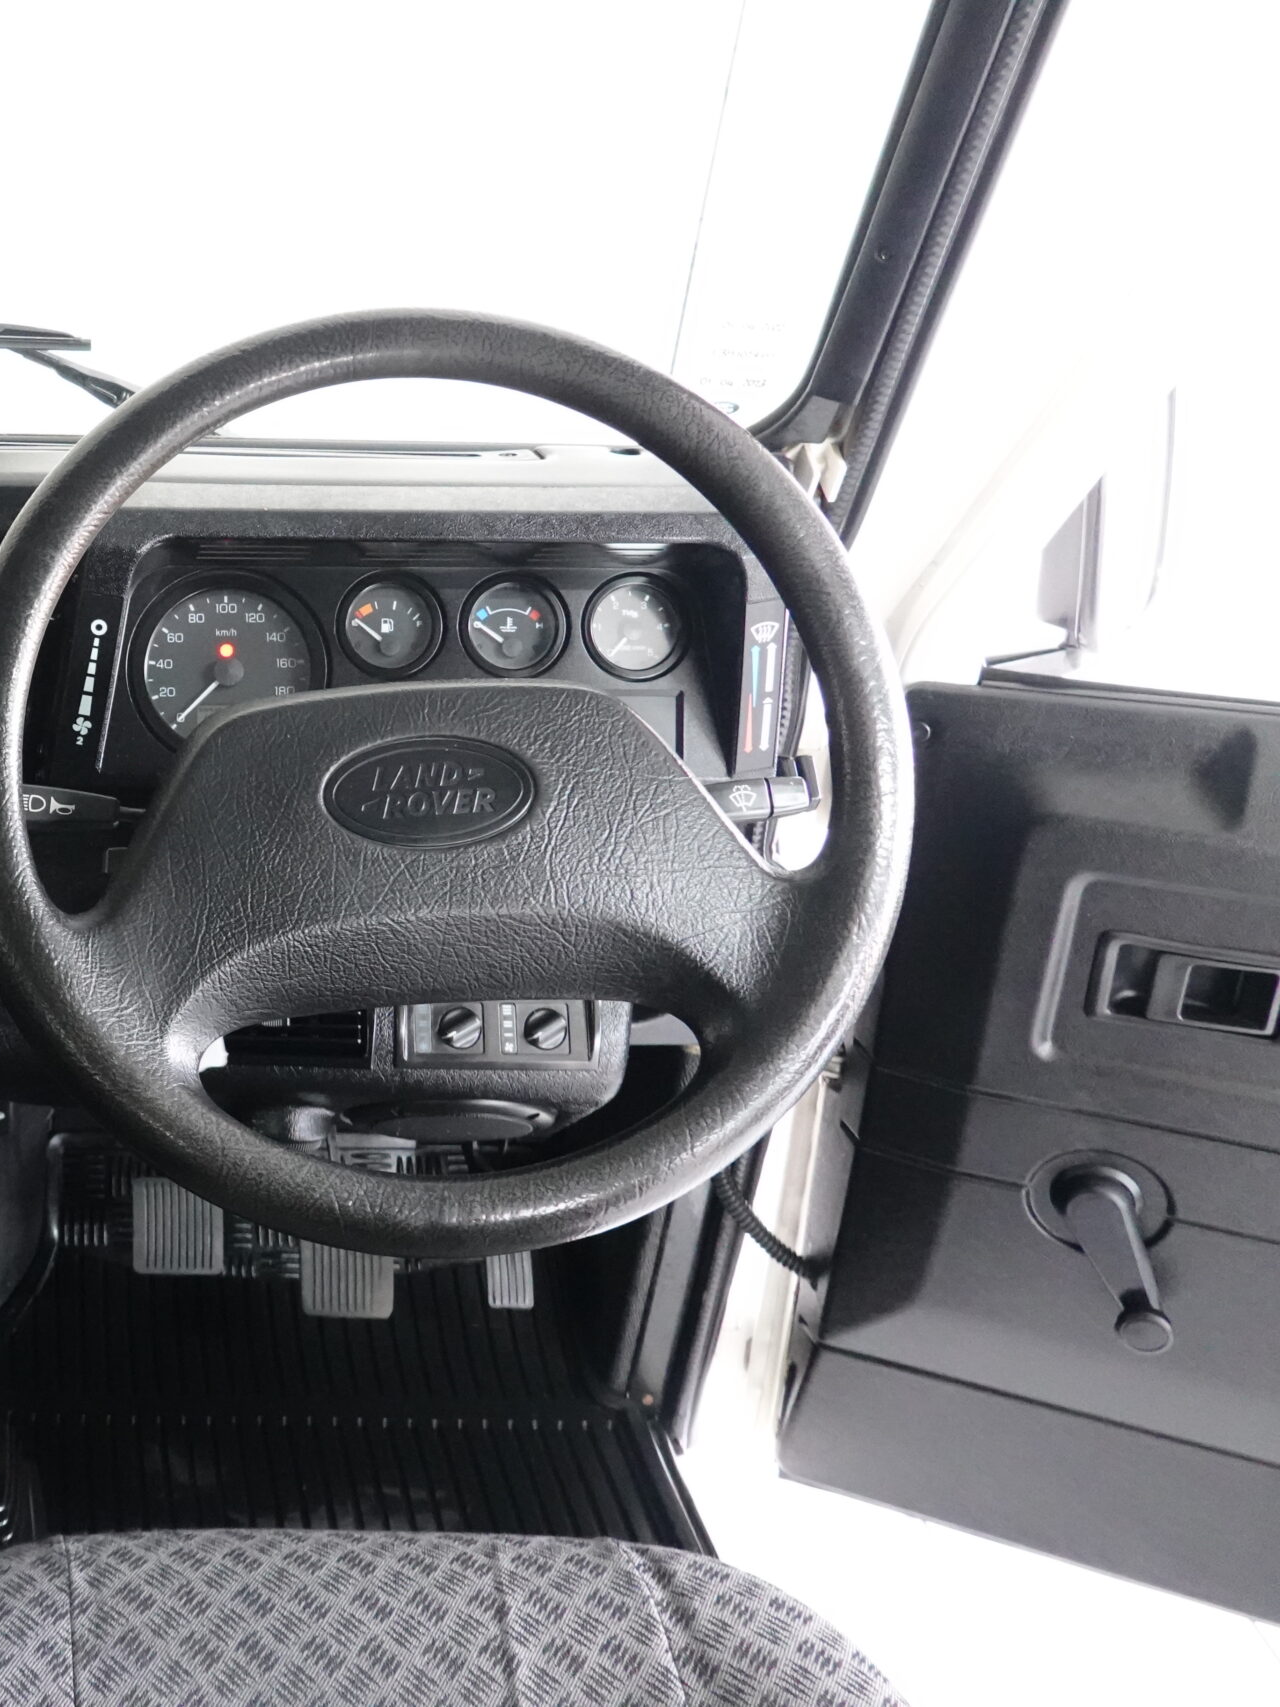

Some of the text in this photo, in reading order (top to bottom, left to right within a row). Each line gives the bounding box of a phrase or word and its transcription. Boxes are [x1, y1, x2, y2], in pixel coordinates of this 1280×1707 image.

[215, 603, 237, 614] 100
[188, 613, 205, 624] 80
[245, 613, 265, 623] 120
[167, 632, 184, 643] 60
[215, 628, 237, 638] km/h
[266, 632, 286, 642] 140
[156, 658, 173, 669] 40
[276, 658, 297, 668] 160
[159, 687, 176, 697] 20
[274, 686, 296, 696] 180
[75, 736, 84, 746] 2
[371, 760, 462, 792] LAND
[382, 787, 497, 820] ROVER
